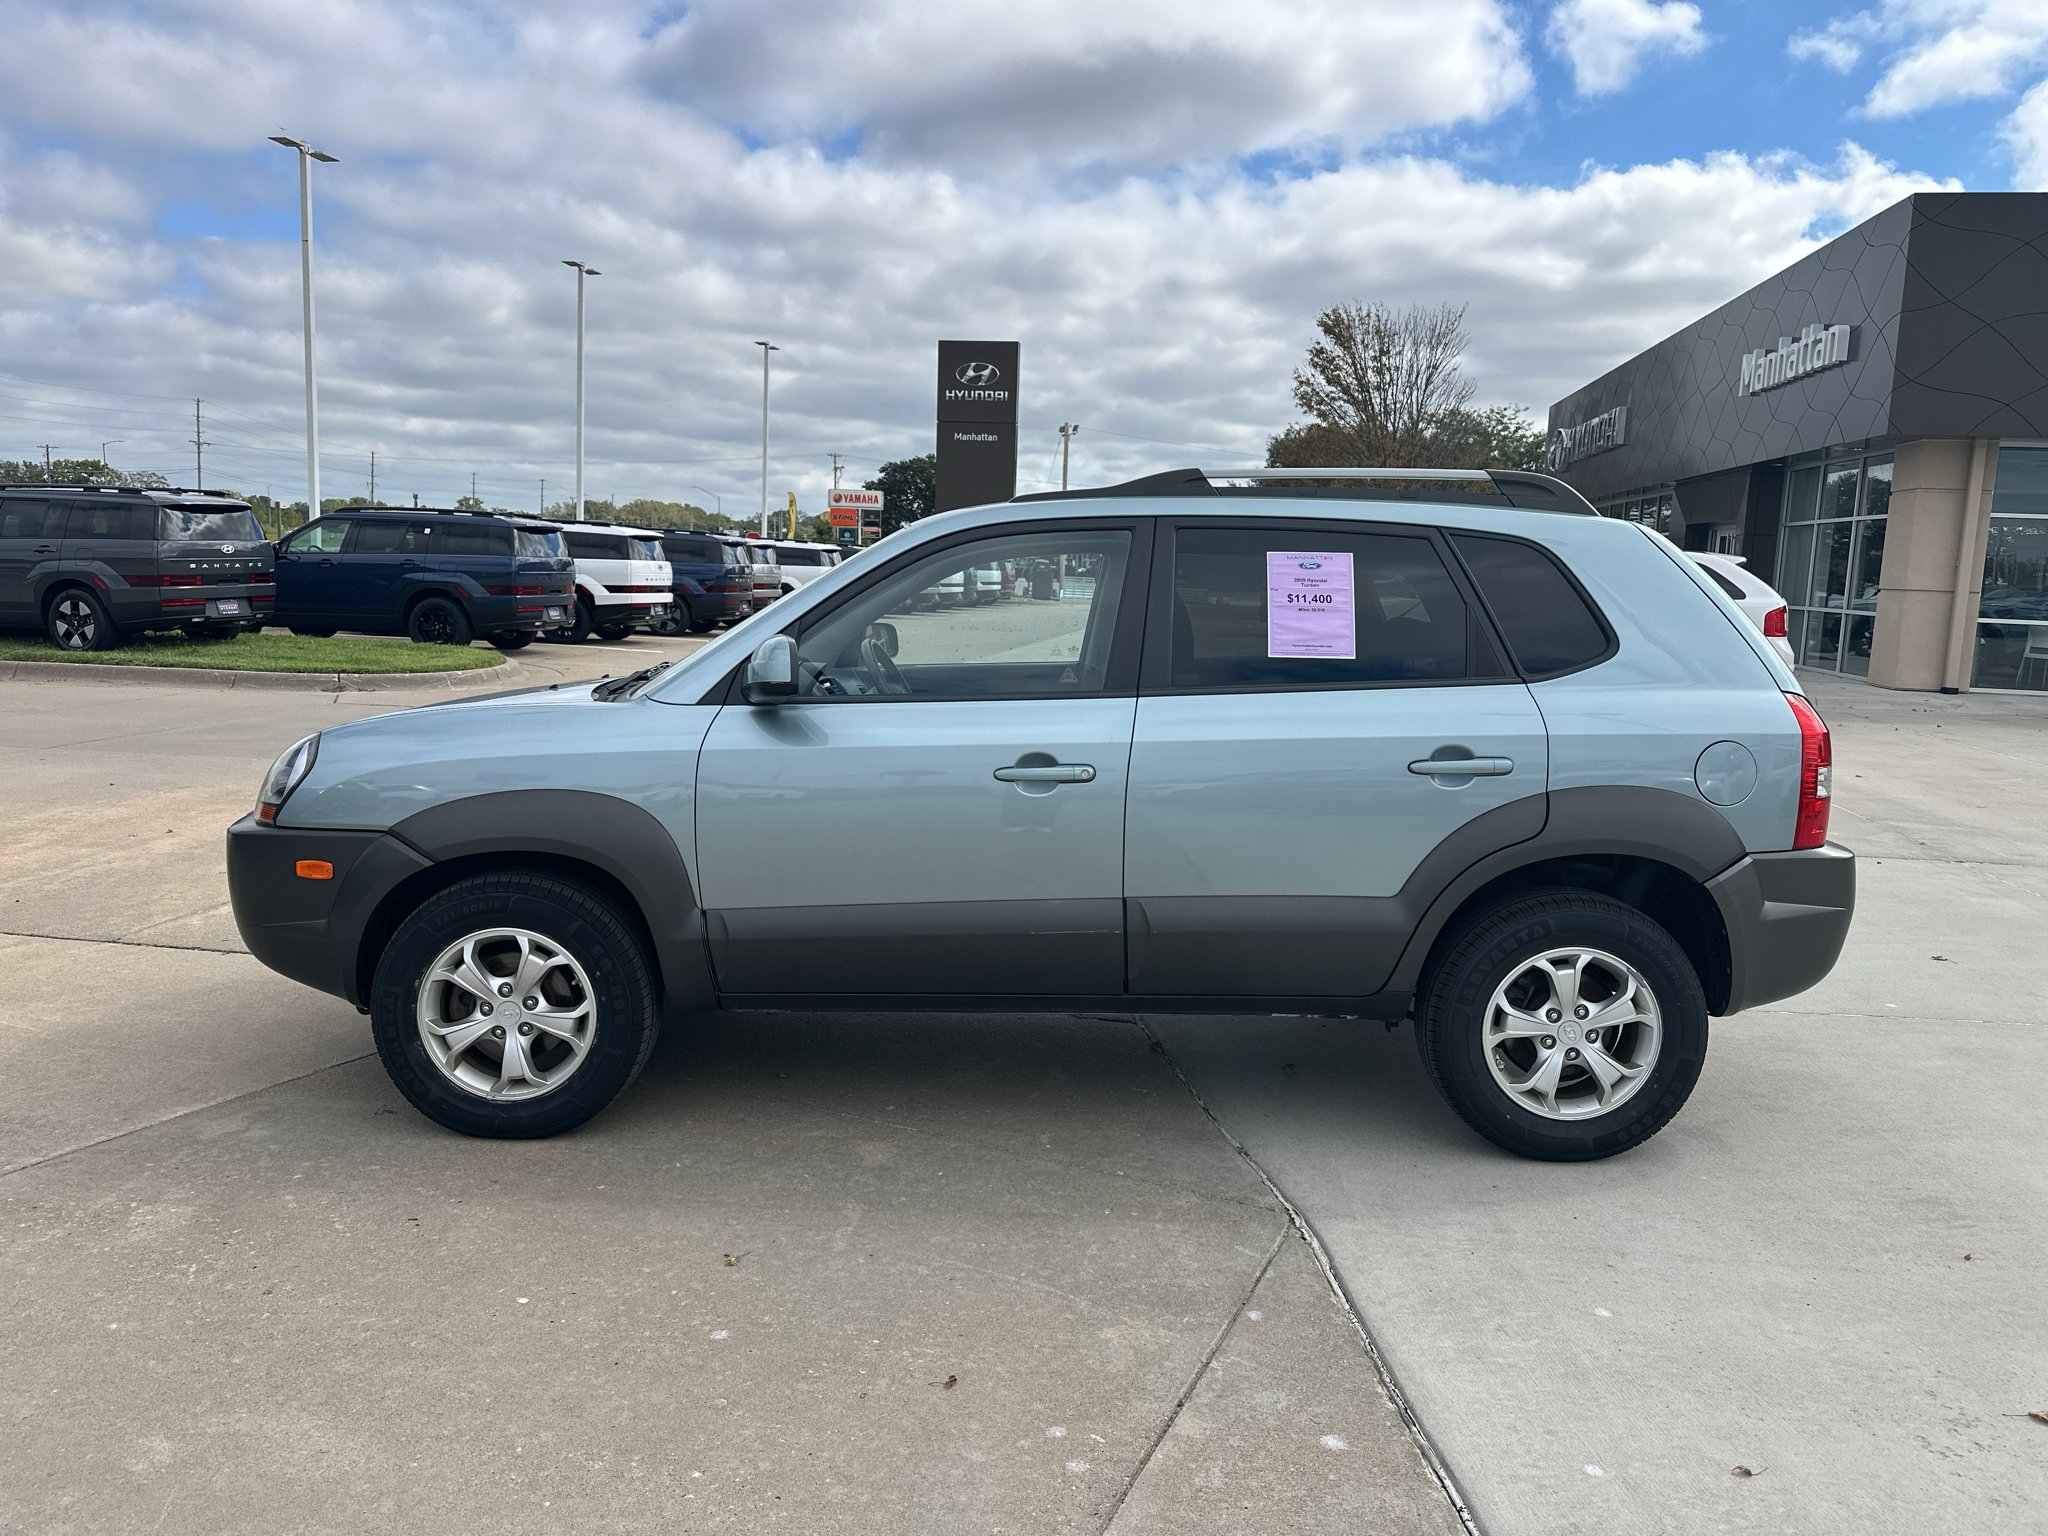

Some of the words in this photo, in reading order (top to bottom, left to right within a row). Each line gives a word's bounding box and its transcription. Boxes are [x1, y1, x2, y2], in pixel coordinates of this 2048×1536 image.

[1739, 324, 1850, 396] Manhattan
[945, 389, 1009, 401] HYUNDAI
[954, 432, 998, 442] Manhattan
[843, 494, 879, 504] YAMAHA
[1287, 593, 1333, 605] $11,400
[1462, 925, 1547, 1001] ADVANTA
